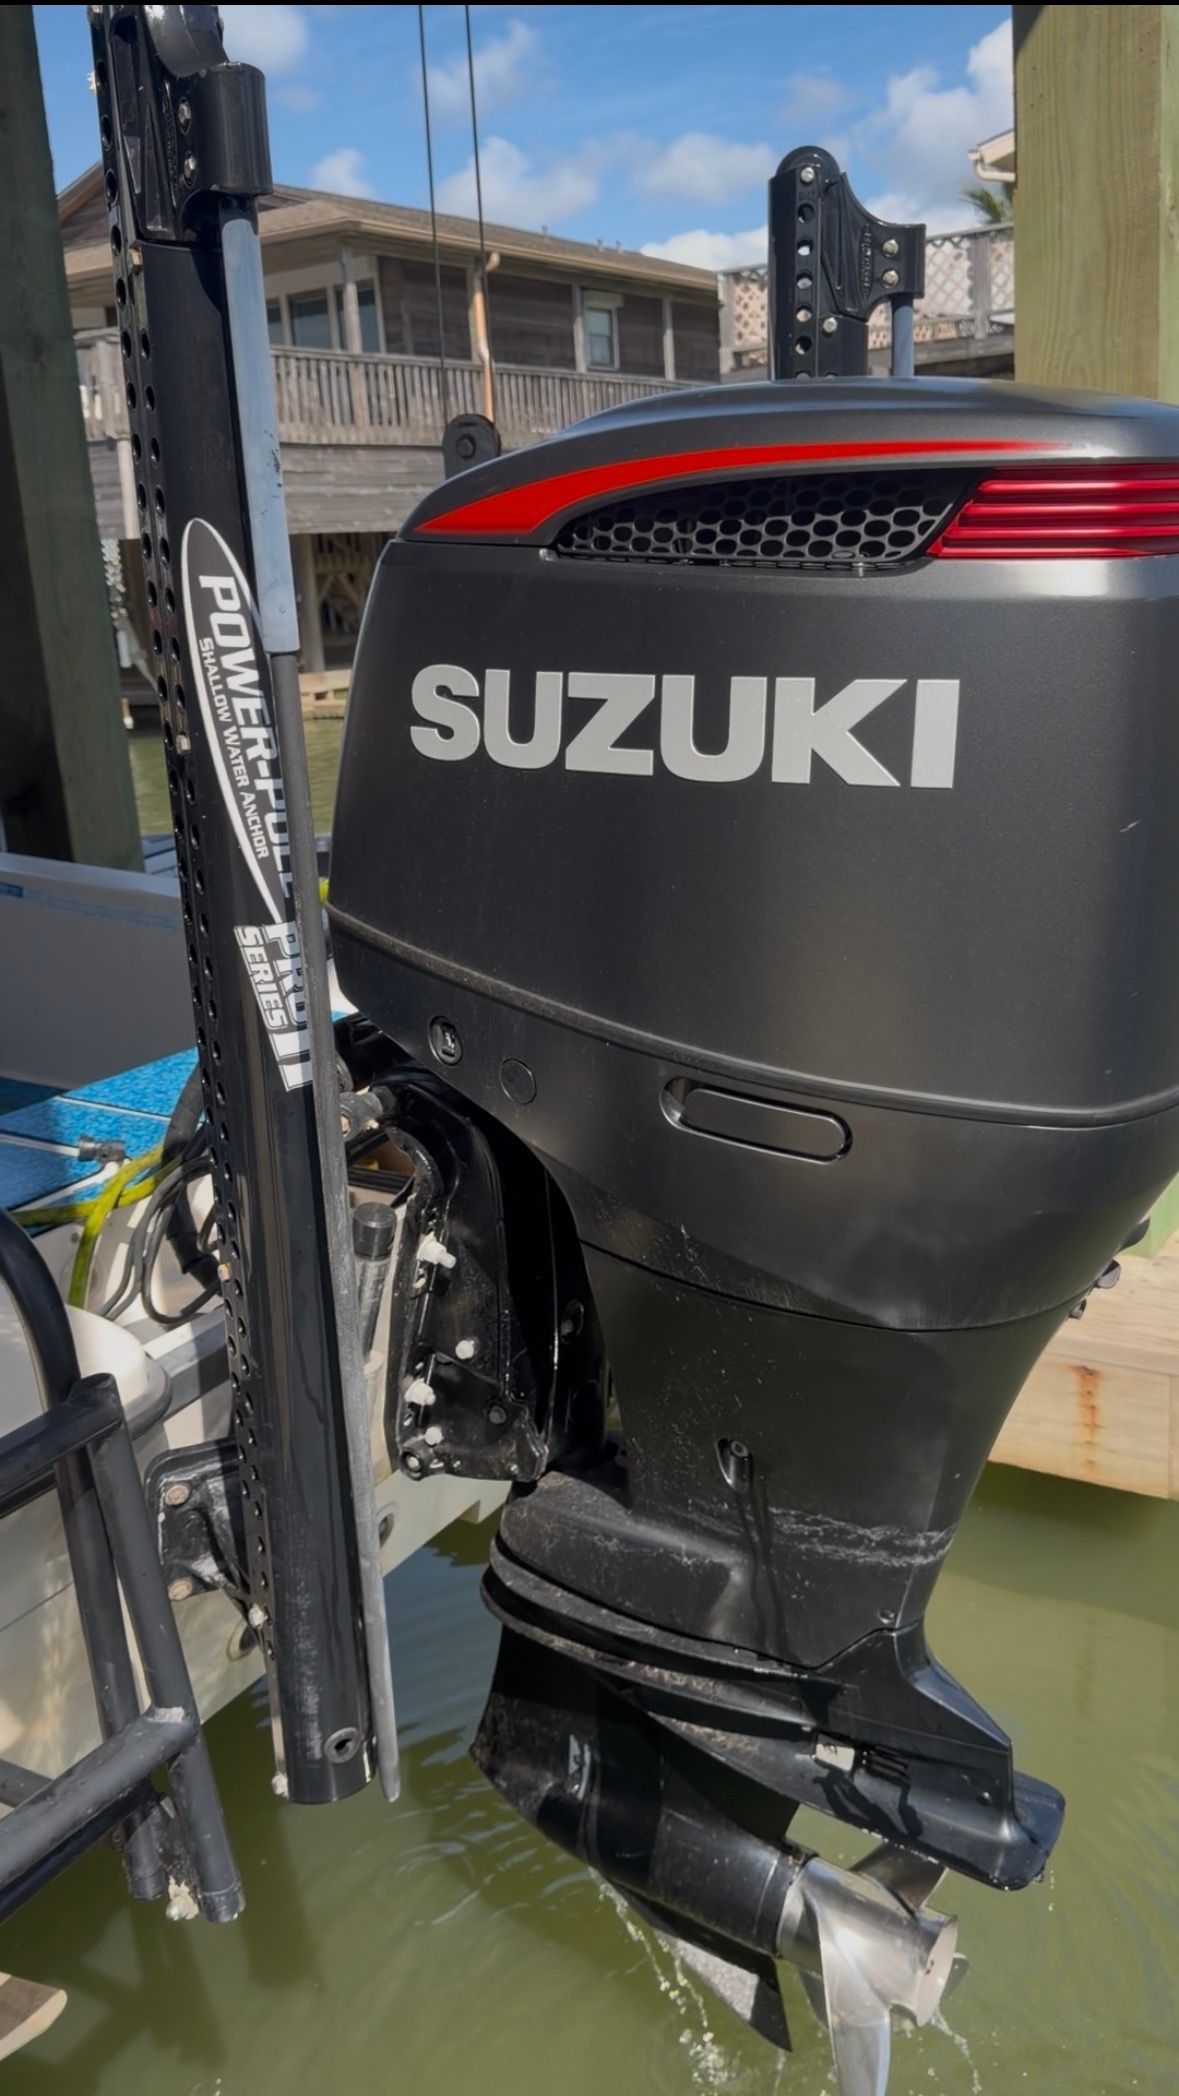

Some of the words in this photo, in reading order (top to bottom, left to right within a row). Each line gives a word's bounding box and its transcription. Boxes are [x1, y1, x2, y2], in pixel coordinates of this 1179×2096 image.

[200, 637, 232, 722] SHALLOW
[223, 726, 250, 788] WATER
[240, 791, 270, 859] ANCHOR
[410, 664, 960, 788] SUZUKI
[235, 926, 288, 1029] SERIES
